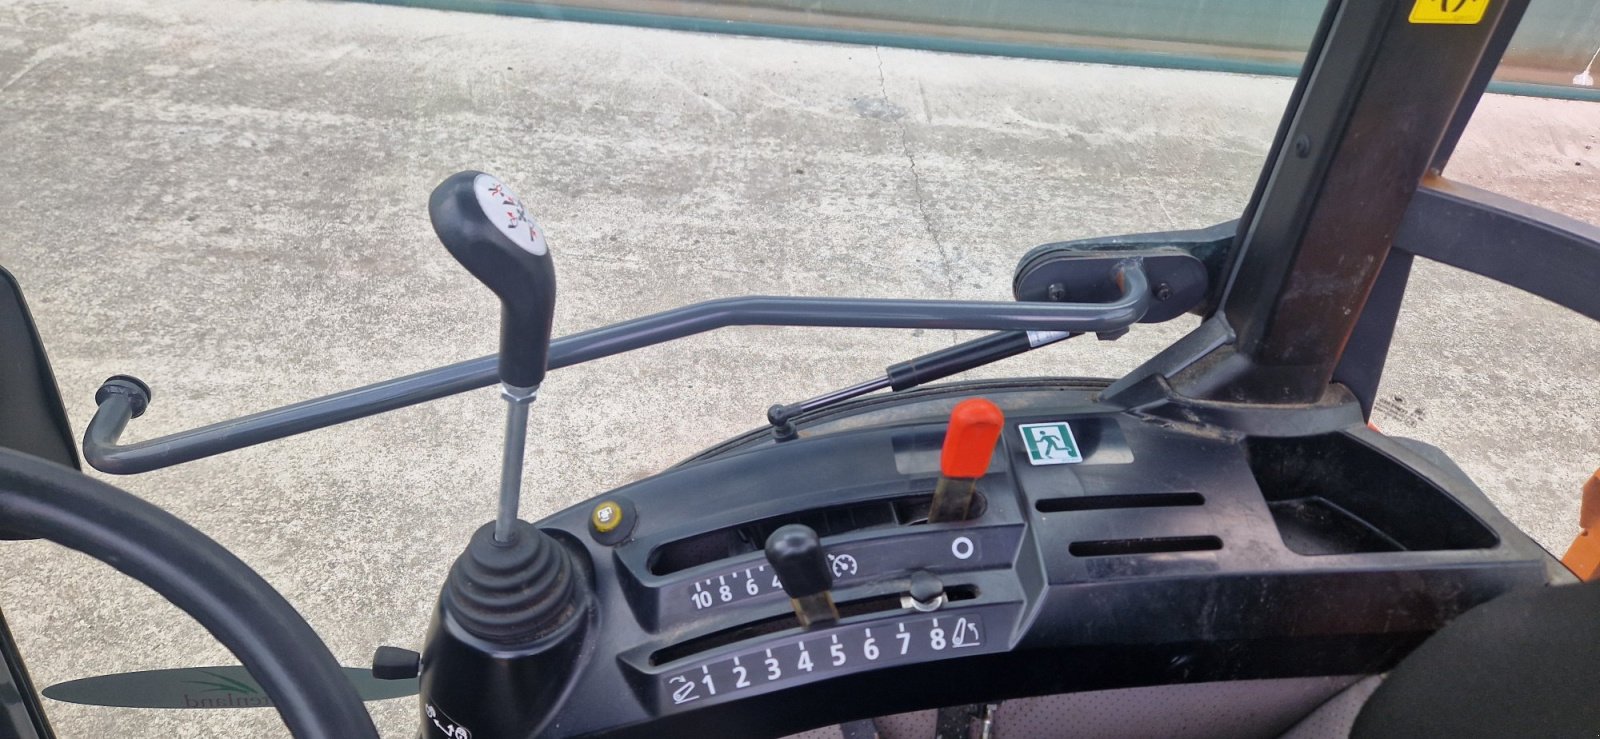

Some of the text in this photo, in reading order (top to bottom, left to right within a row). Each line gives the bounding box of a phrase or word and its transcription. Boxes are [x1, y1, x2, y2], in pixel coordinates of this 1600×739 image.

[691, 590, 713, 609] 10
[719, 585, 733, 602] 8
[745, 578, 759, 596] 6
[701, 627, 947, 695] 1 2 3 4 5 6 7 8
